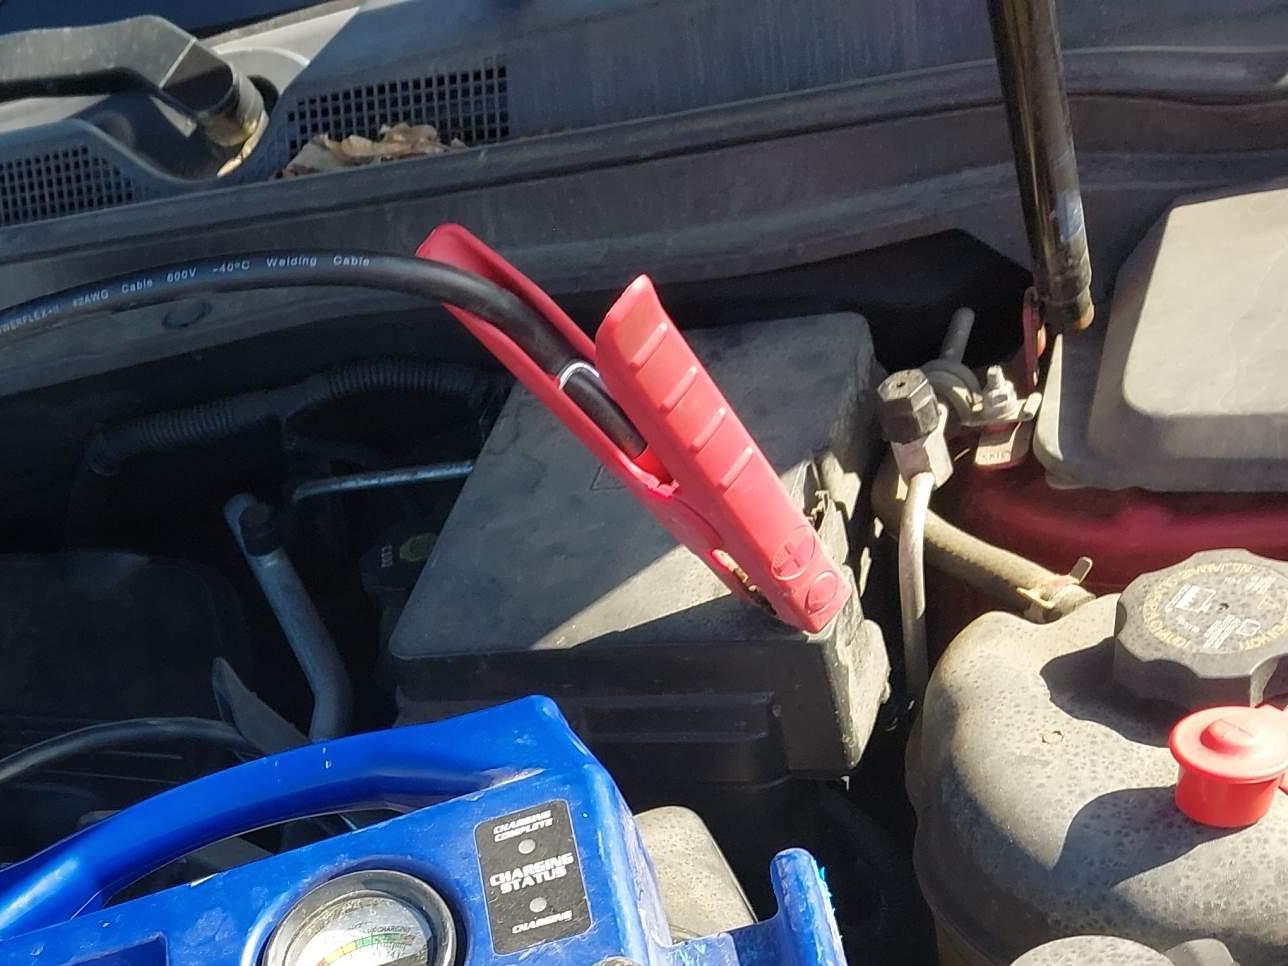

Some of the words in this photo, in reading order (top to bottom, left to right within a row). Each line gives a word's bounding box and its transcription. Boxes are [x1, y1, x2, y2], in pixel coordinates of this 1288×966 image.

[121, 278, 153, 294] Cable
[167, 267, 197, 283] 600V
[266, 255, 318, 267] Welding
[333, 254, 370, 267] Cable
[489, 852, 575, 888] CHARGING
[500, 866, 568, 895] STATUS
